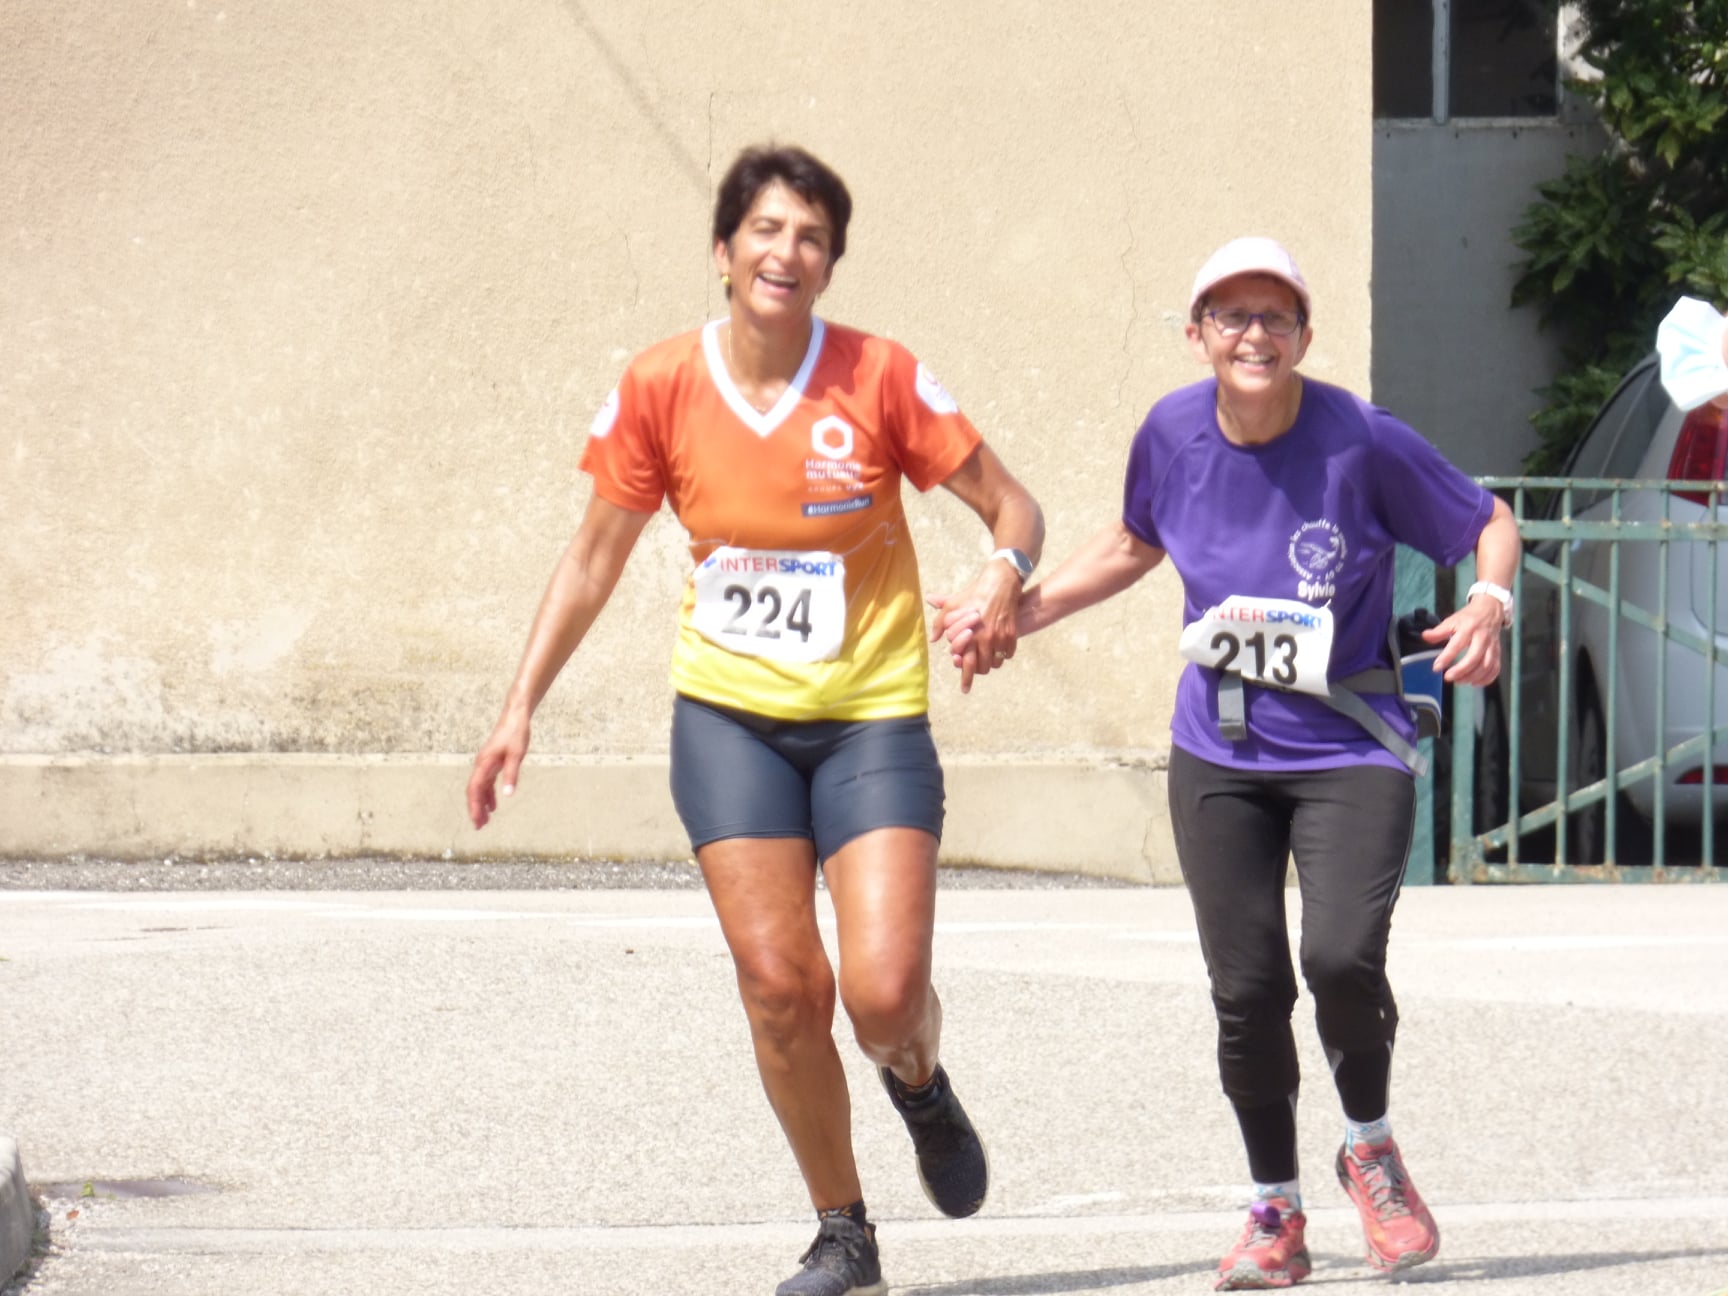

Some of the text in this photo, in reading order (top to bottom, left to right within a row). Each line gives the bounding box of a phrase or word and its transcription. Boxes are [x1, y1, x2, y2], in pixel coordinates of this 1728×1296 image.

[720, 557, 837, 577] INTERSPORT
[721, 583, 813, 644] 224
[1210, 630, 1298, 686] 213
